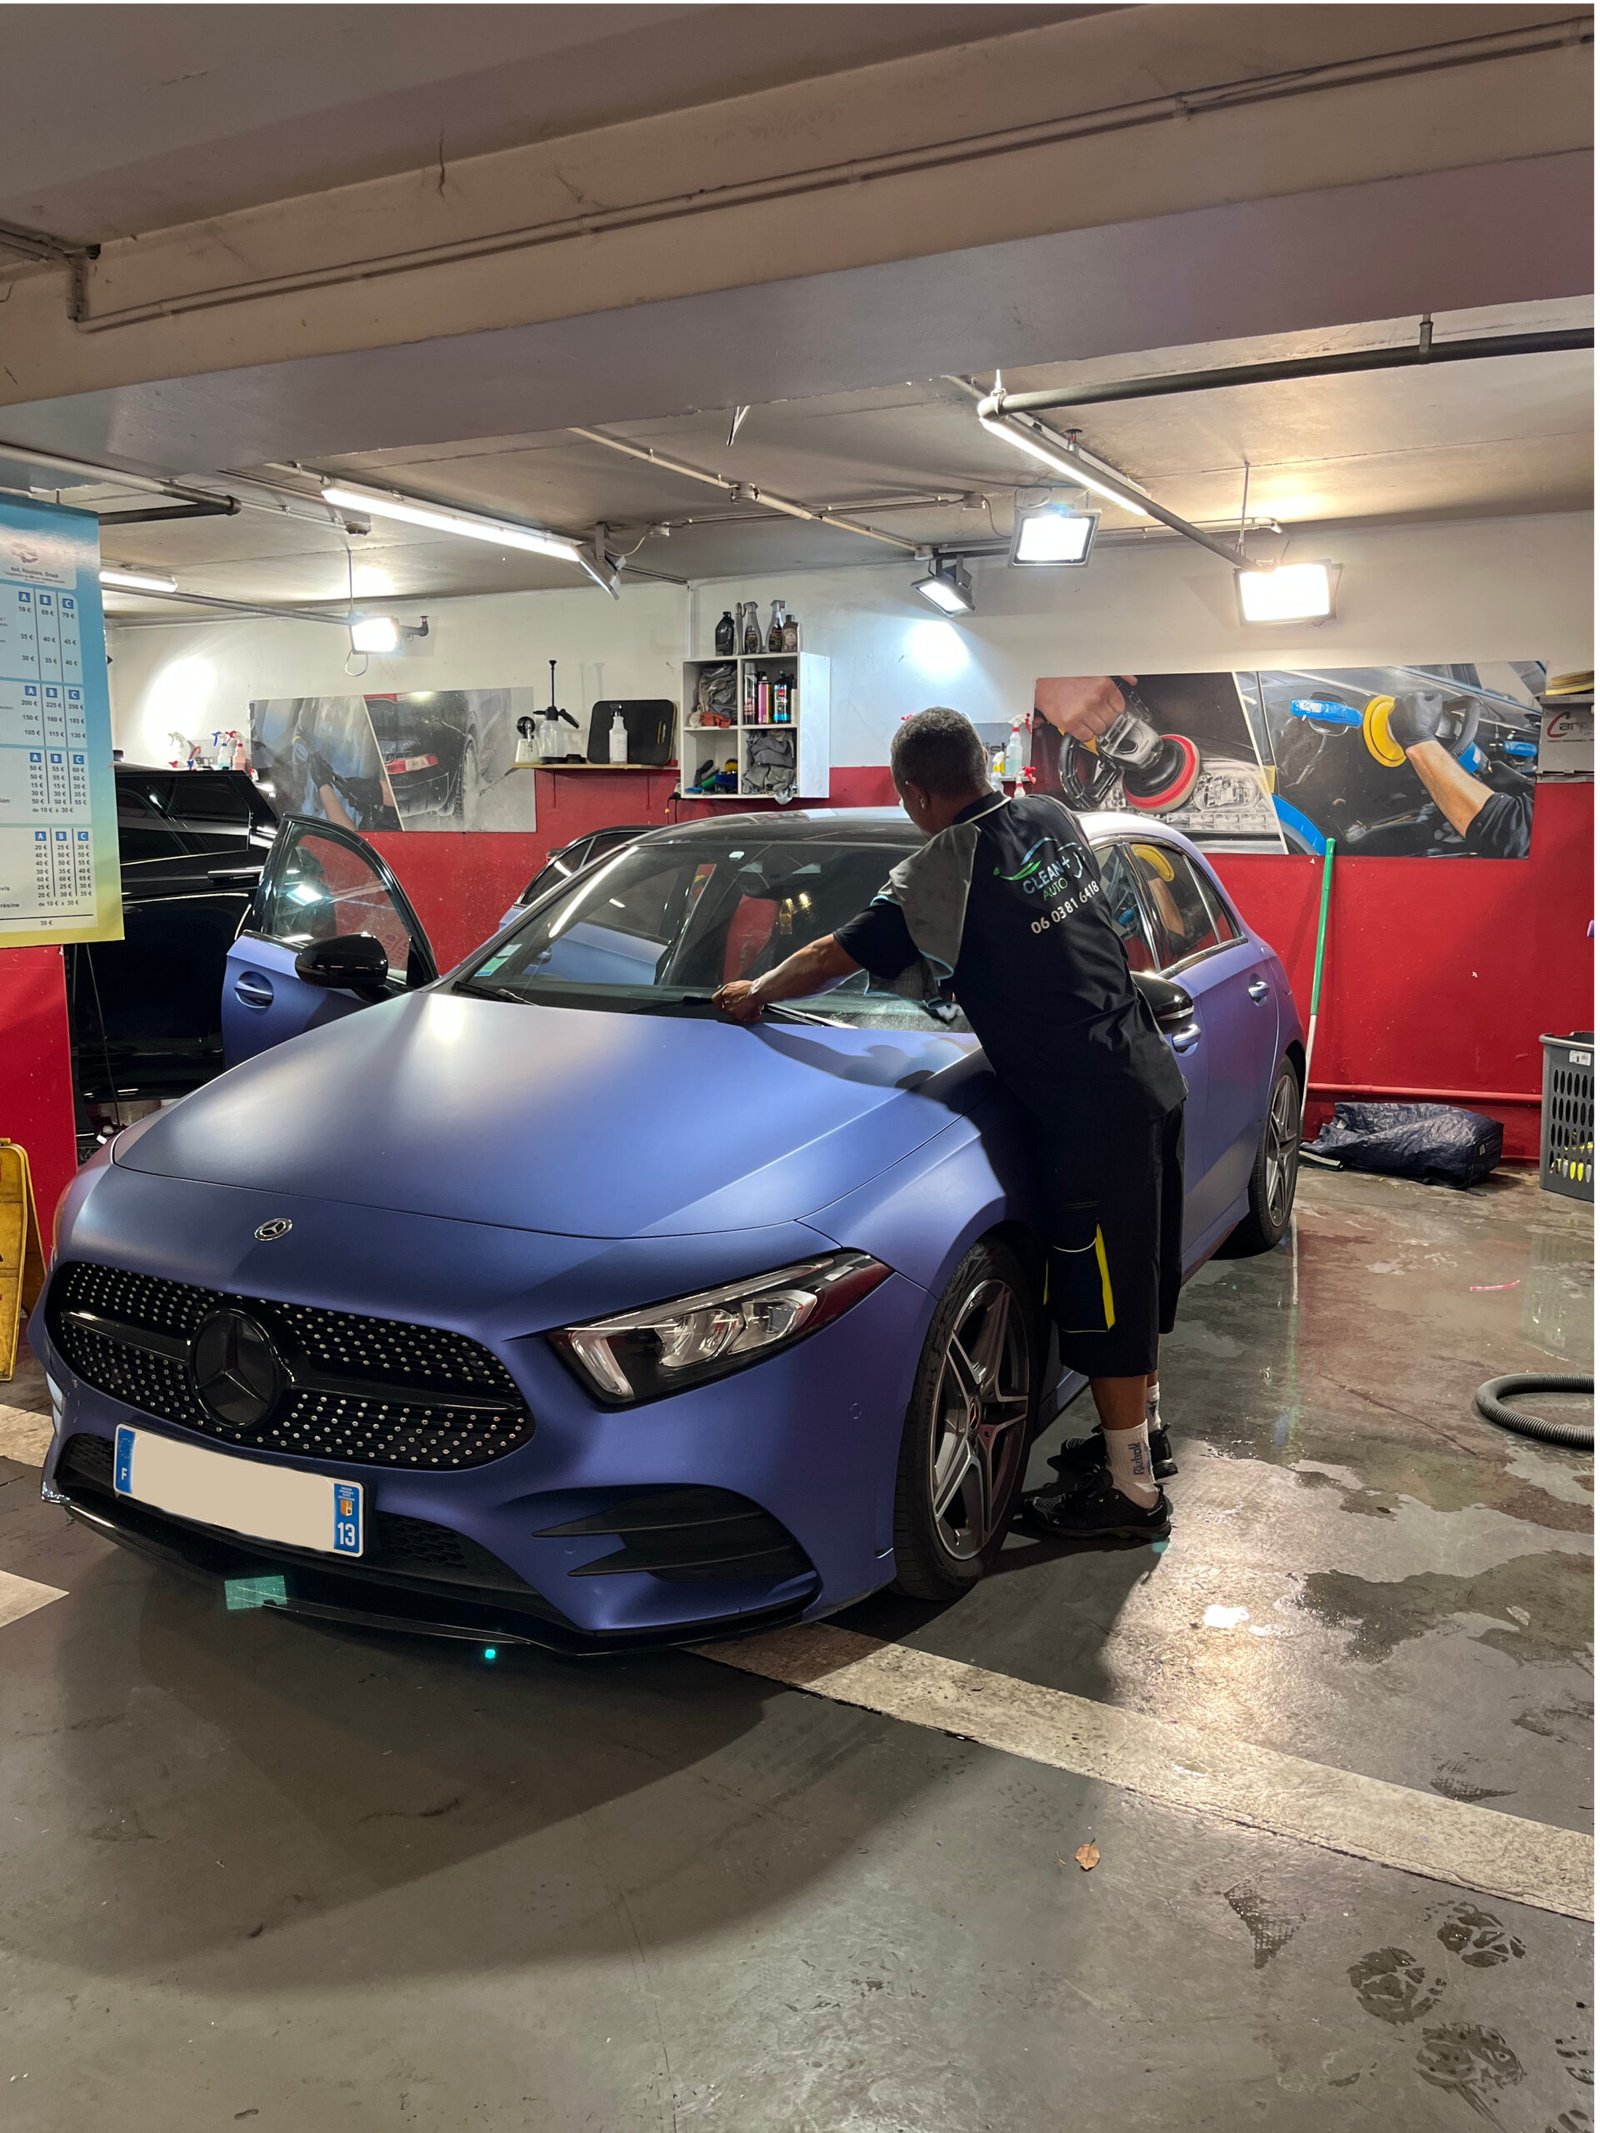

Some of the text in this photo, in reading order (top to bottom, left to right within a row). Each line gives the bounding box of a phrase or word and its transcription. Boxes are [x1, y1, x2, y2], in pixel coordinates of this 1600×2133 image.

[1043, 877, 1069, 901] AUTO
[1031, 917, 1050, 934] 06
[121, 1467, 128, 1481] F
[337, 1522, 356, 1547] 13
